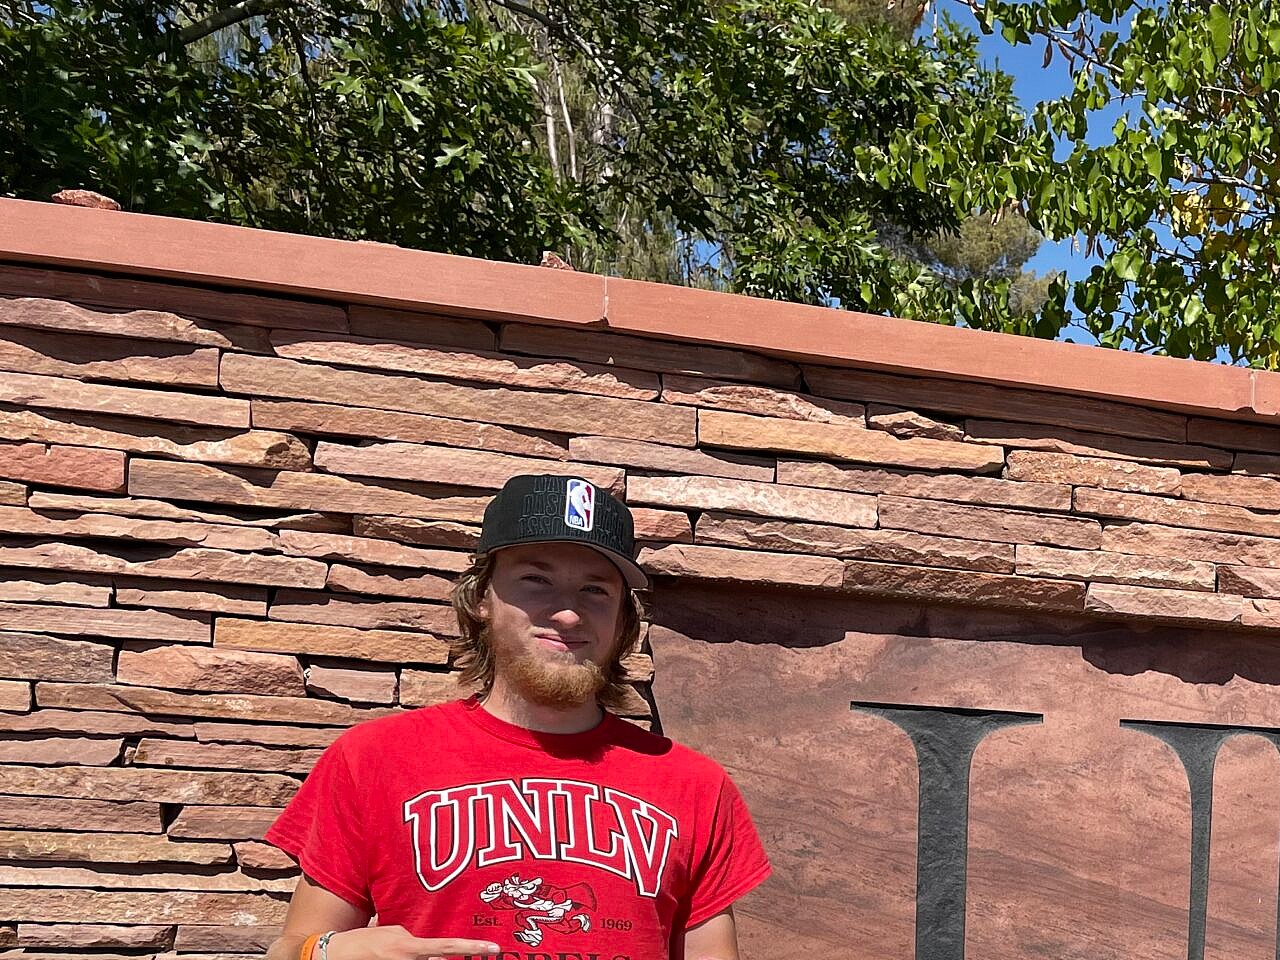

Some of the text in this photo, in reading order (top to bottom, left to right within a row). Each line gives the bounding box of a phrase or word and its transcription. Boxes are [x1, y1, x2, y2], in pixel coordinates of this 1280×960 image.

[569, 515, 584, 527] NBA
[403, 778, 678, 897] UNLV
[472, 914, 633, 931] Est. 1969
